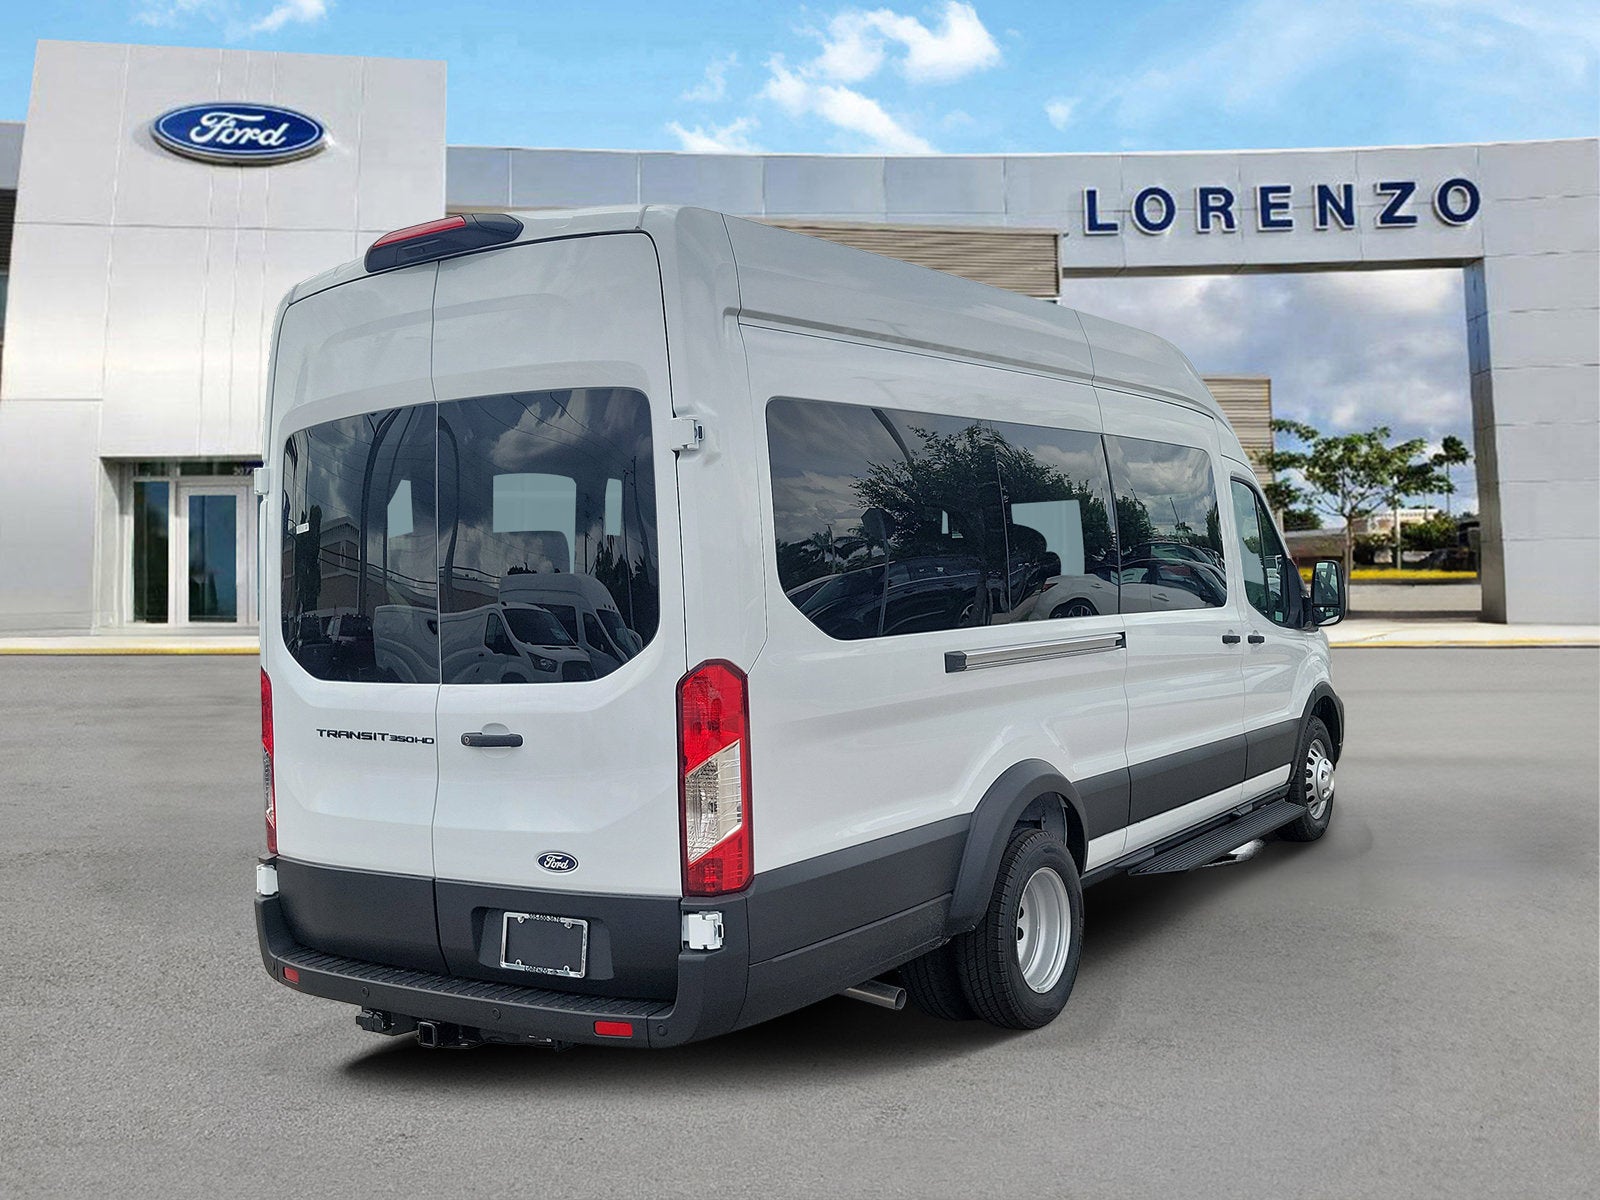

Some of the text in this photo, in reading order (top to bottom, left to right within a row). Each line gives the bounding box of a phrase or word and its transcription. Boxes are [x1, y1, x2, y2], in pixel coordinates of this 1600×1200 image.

[189, 111, 290, 147] Ford
[1083, 177, 1481, 235] LORENZO
[543, 854, 569, 870] Ford
